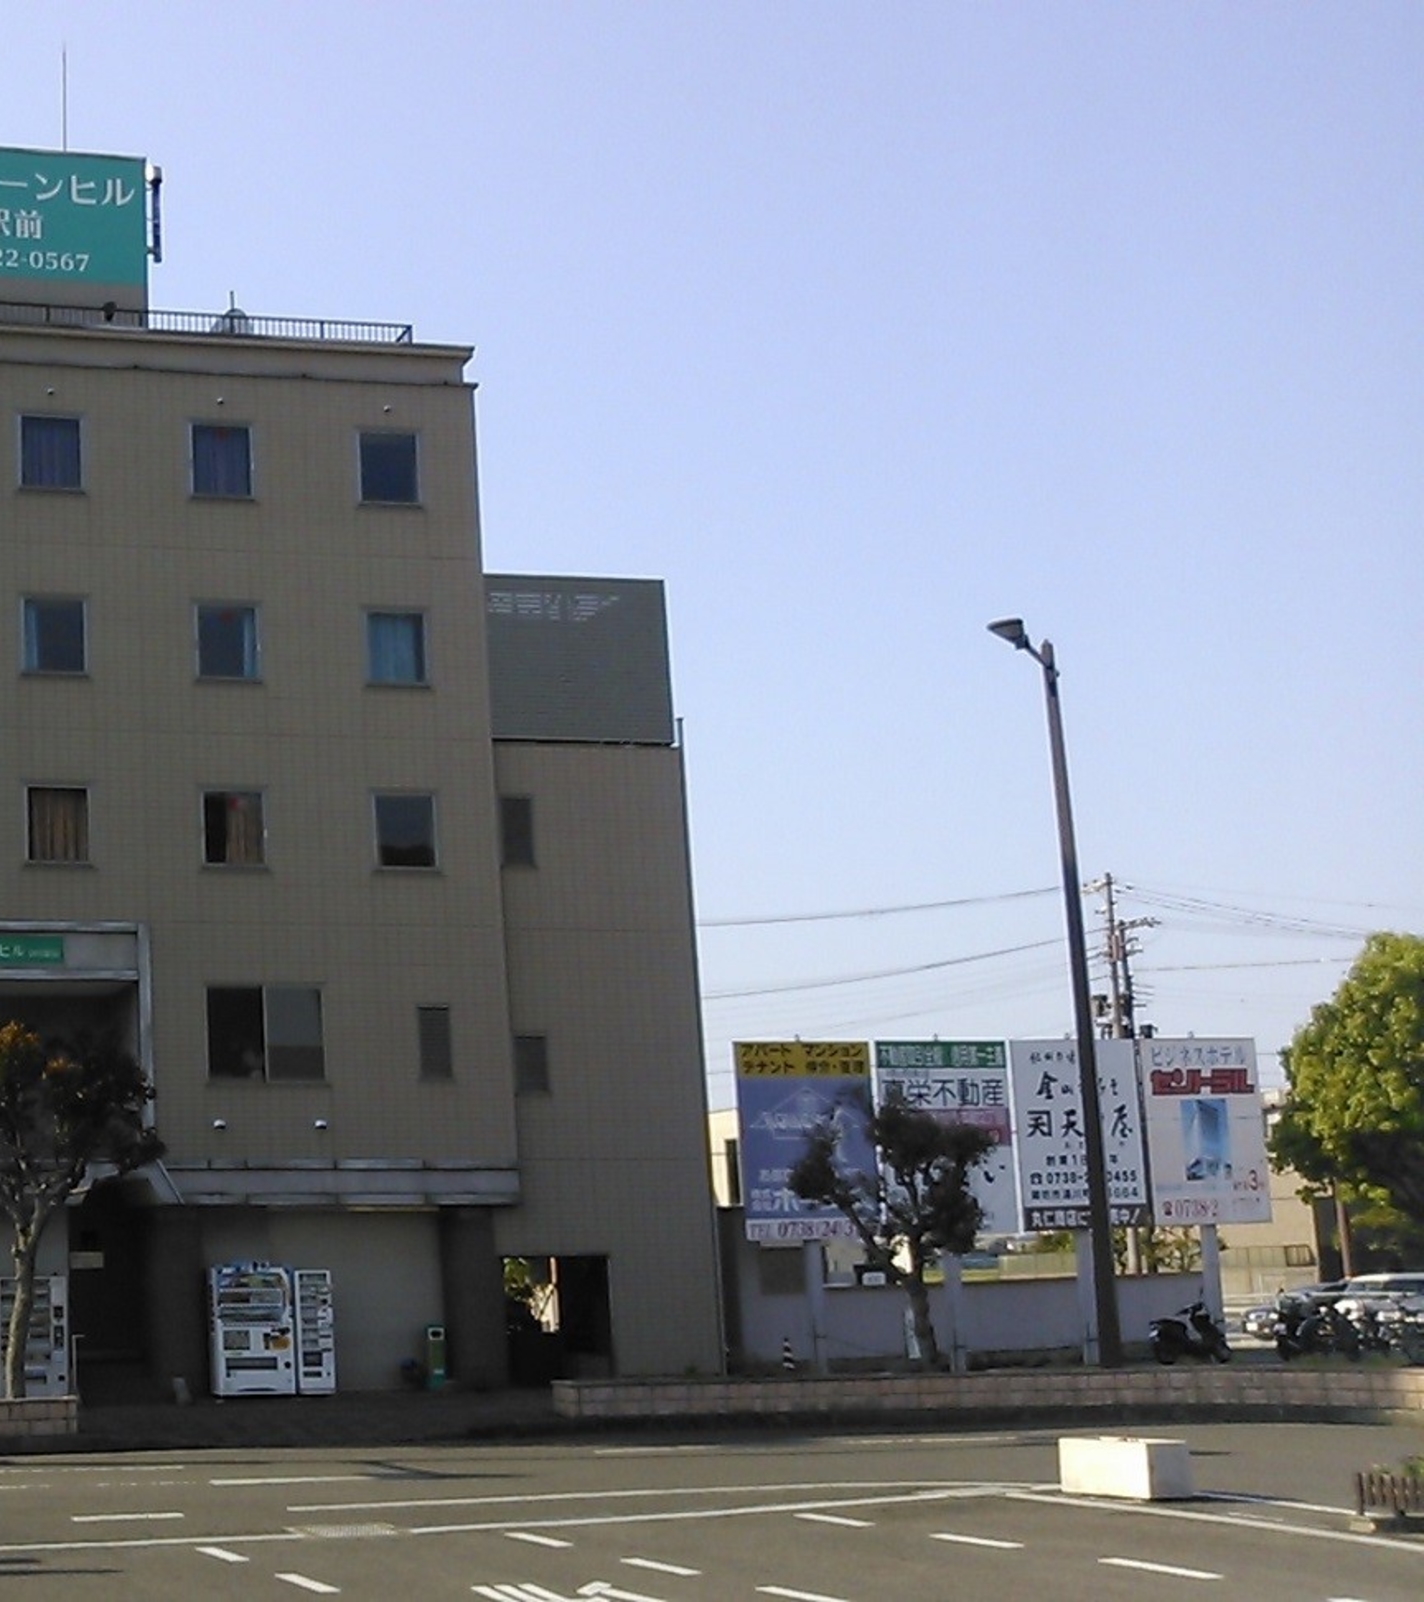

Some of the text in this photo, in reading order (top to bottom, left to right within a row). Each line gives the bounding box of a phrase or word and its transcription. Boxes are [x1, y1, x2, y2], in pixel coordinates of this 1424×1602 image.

[741, 1044, 791, 1057] アパート
[802, 1044, 863, 1057] マンション
[742, 1060, 795, 1074] テナント
